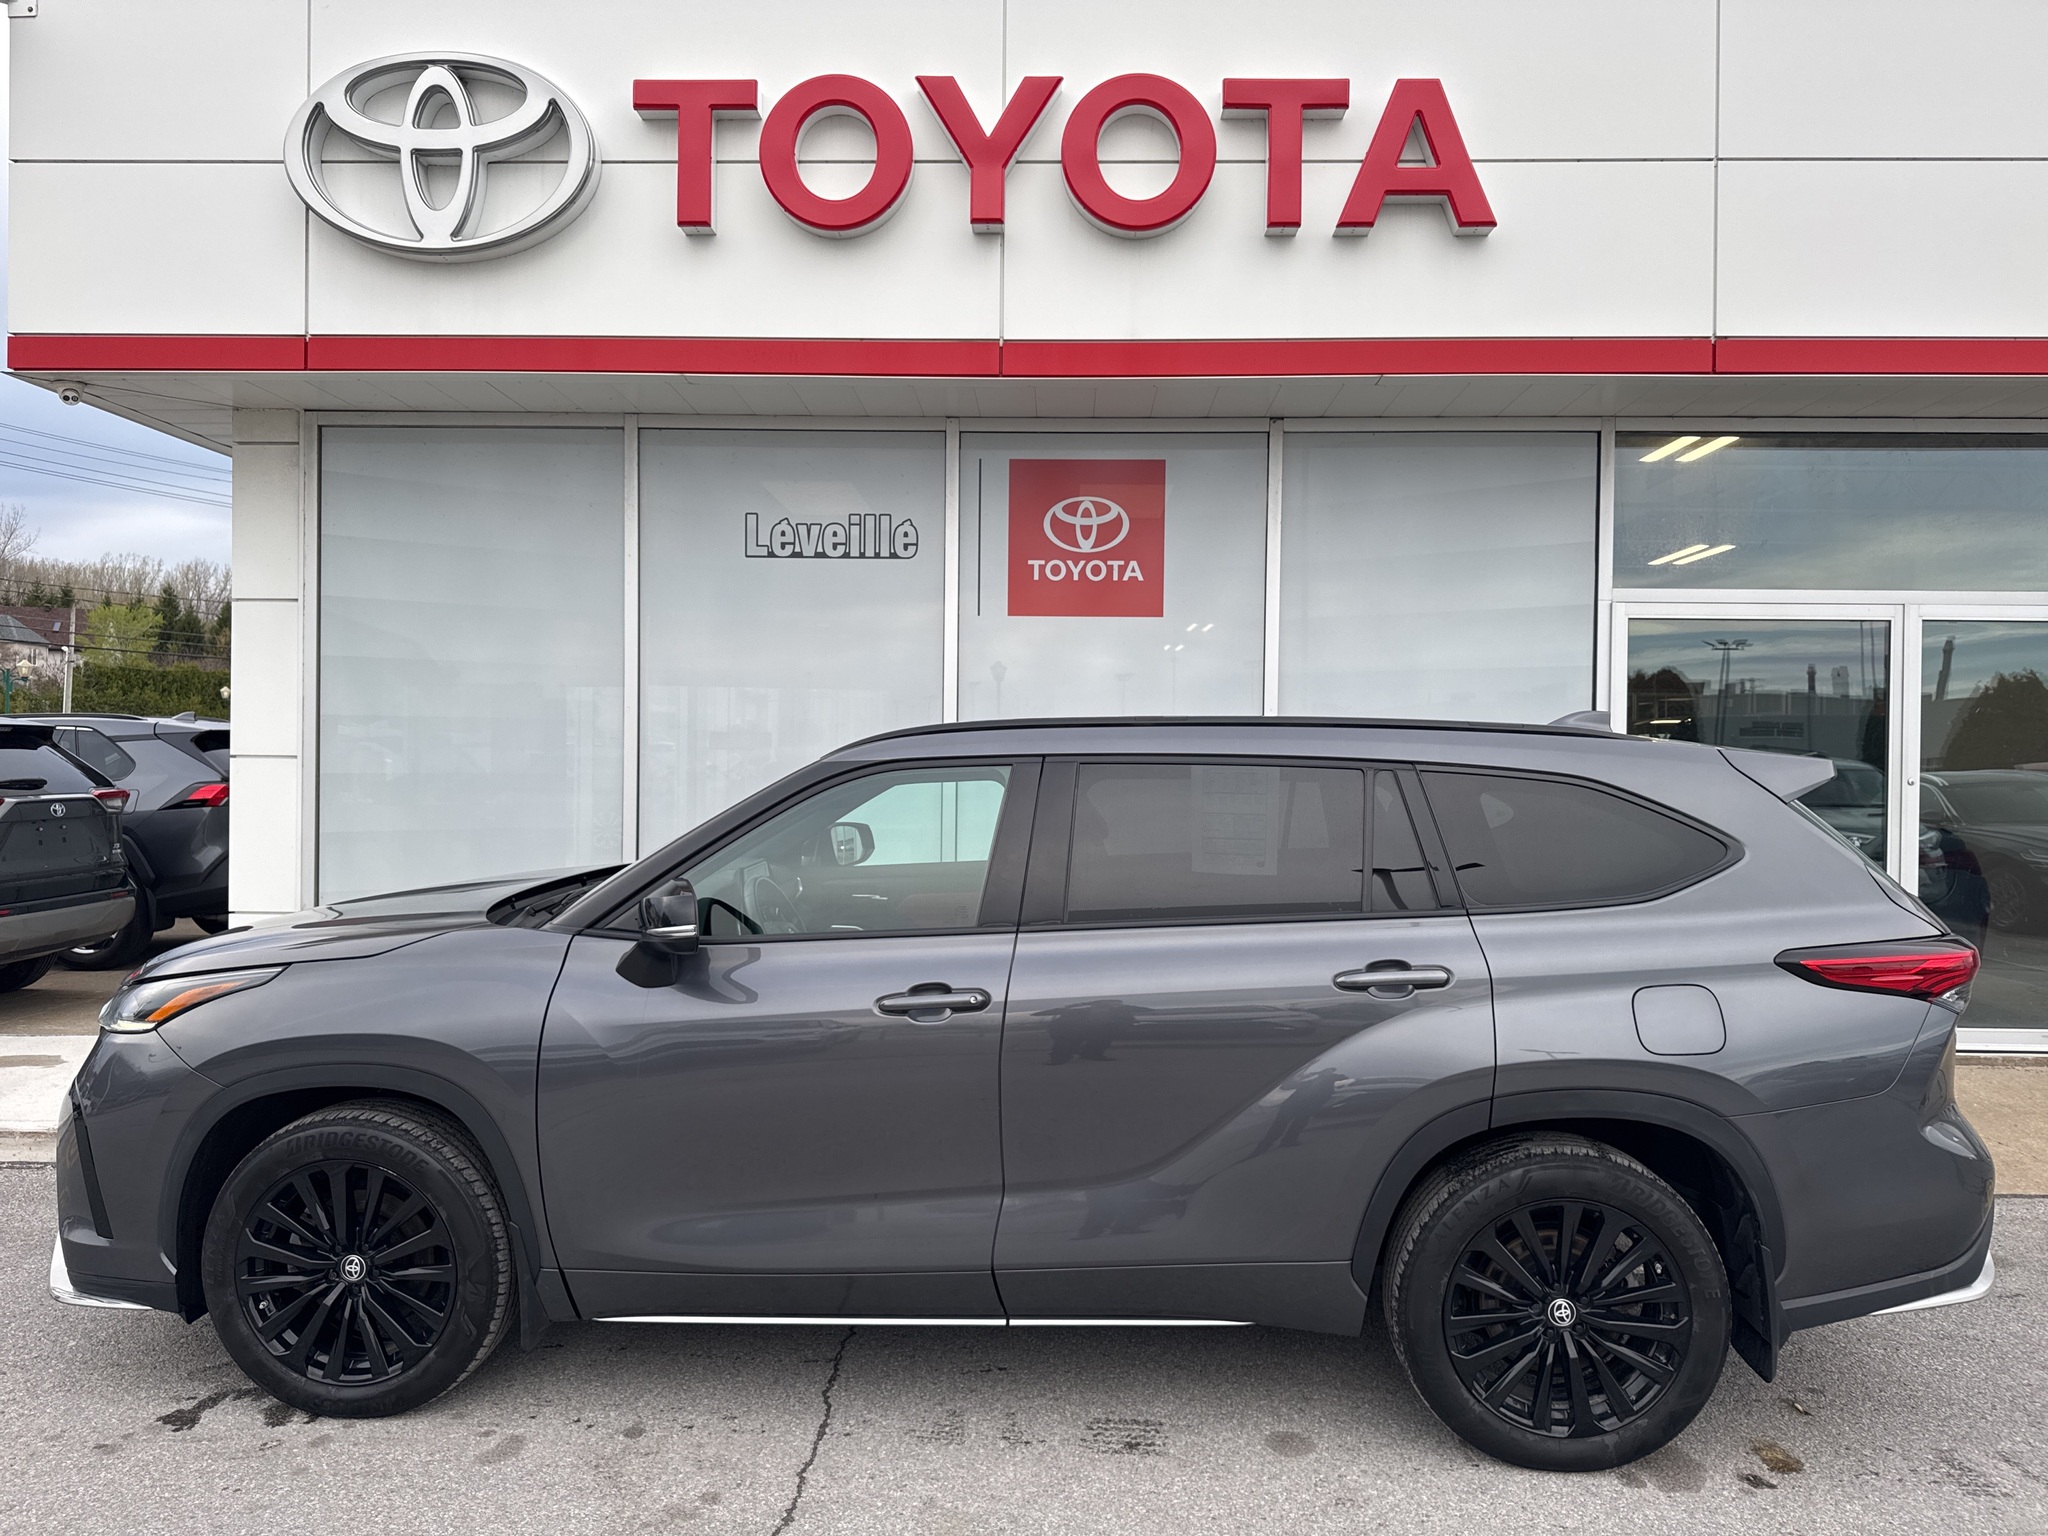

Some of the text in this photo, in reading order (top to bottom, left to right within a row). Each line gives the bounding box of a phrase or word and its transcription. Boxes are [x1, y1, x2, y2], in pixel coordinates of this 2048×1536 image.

[632, 72, 1497, 239] TOYOTA
[744, 512, 919, 560] Léveillé
[1027, 559, 1144, 582] TOYOTA
[286, 1131, 430, 1174] BRIDGESTONE
[1434, 1178, 1511, 1242] ALENZA
[1608, 1173, 1722, 1299] BRIDGESTONE
